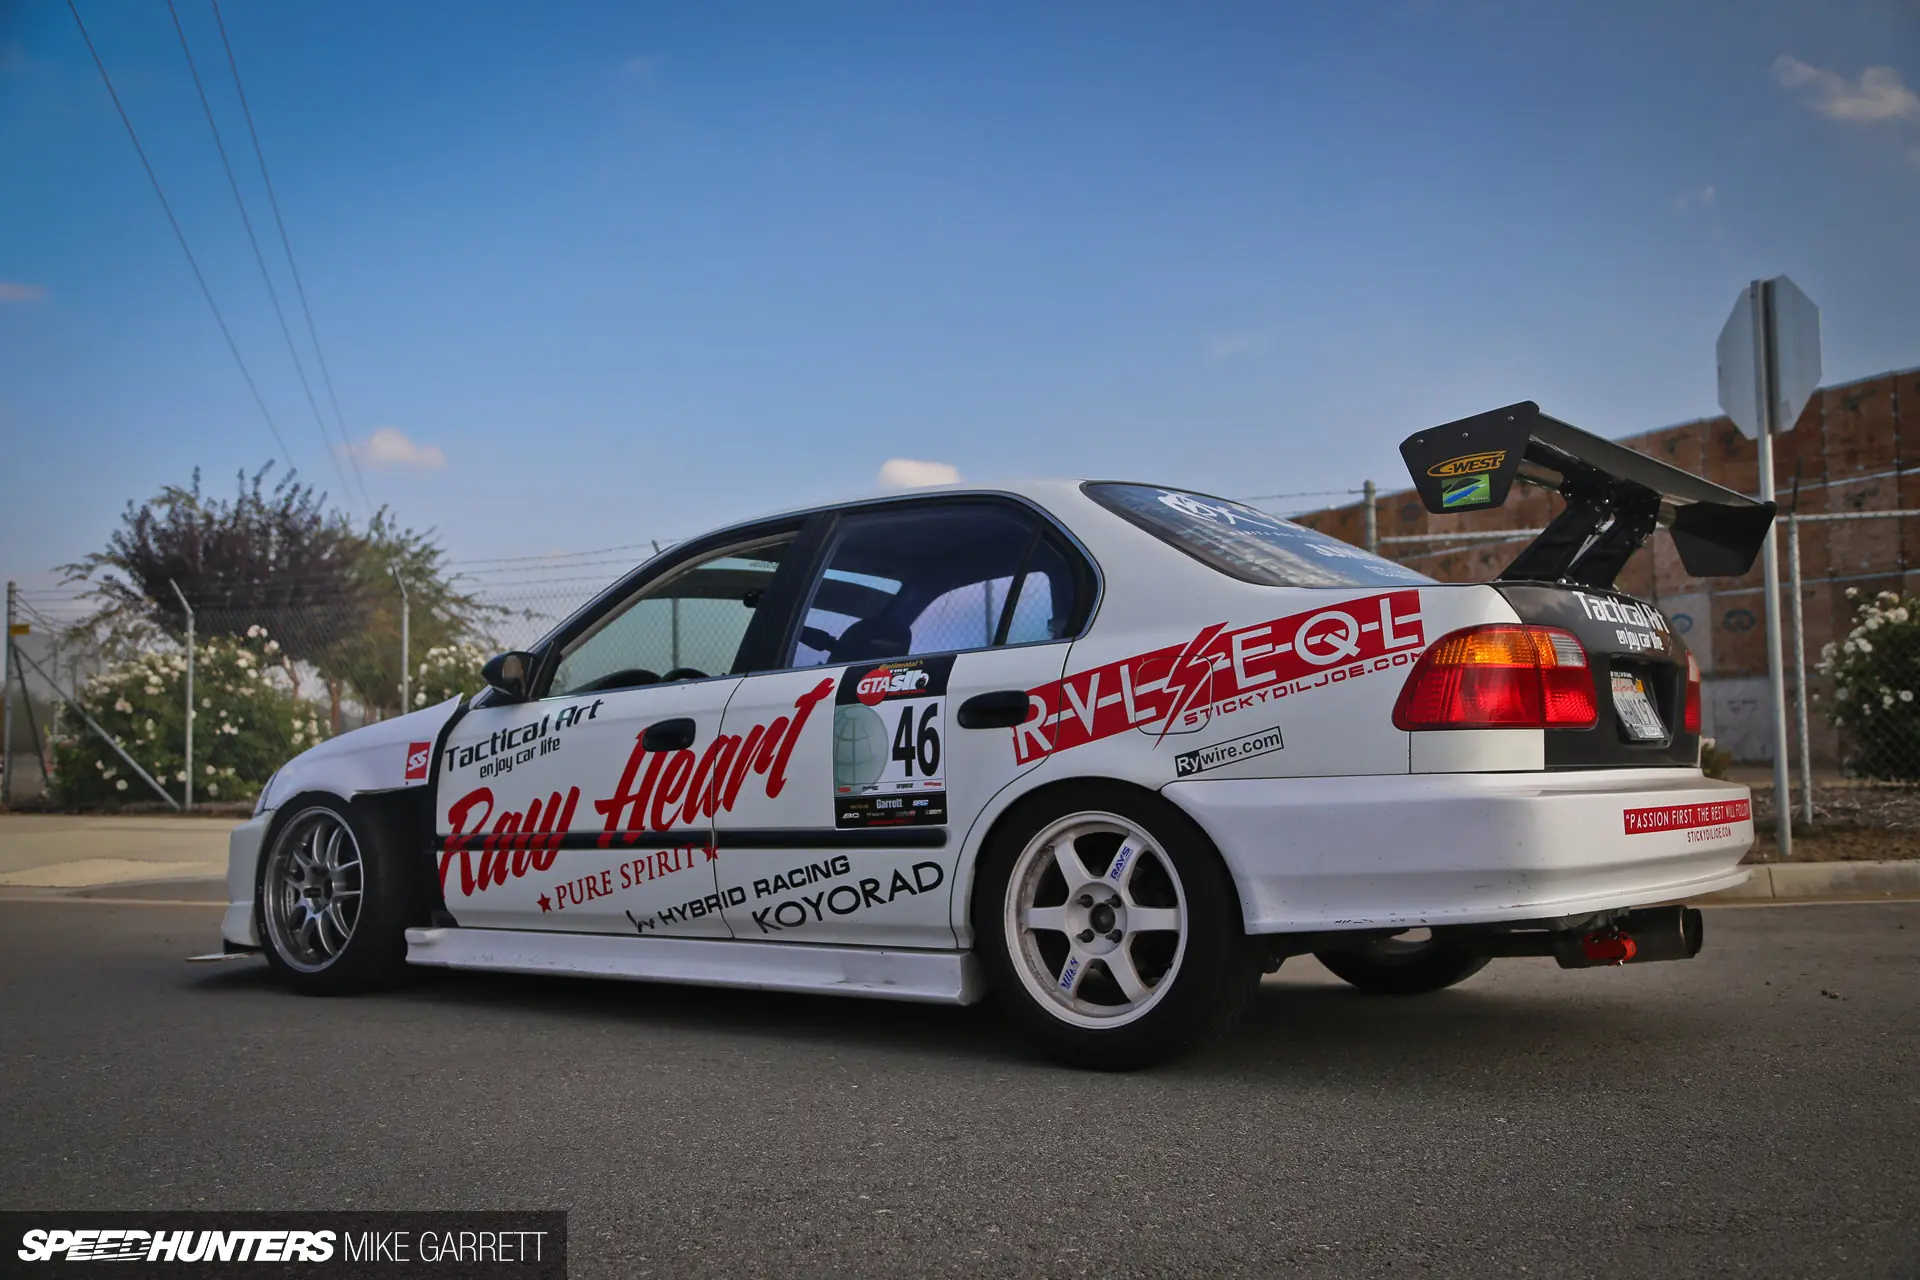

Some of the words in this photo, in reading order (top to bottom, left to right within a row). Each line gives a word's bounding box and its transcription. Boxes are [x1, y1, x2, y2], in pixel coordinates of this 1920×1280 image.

[1572, 591, 1650, 628] Tactical
[1641, 604, 1670, 634] Art
[445, 714, 550, 772] Tactical
[555, 699, 604, 732] Art
[480, 756, 513, 779] enjoy
[516, 747, 537, 765] car
[540, 737, 561, 756] life
[892, 702, 941, 777] 46
[1176, 733, 1280, 772] Rywire.com
[876, 798, 903, 809] Garrett
[1697, 807, 1710, 822] THE
[1711, 805, 1724, 820] REST
[439, 786, 581, 900] Raw
[1111, 846, 1130, 880] RAYS
[554, 870, 613, 910] PURE
[619, 843, 695, 890] SPIRIT
[657, 886, 747, 926] HYBRID
[753, 855, 851, 899] RACING
[752, 861, 944, 935] KOYORAD
